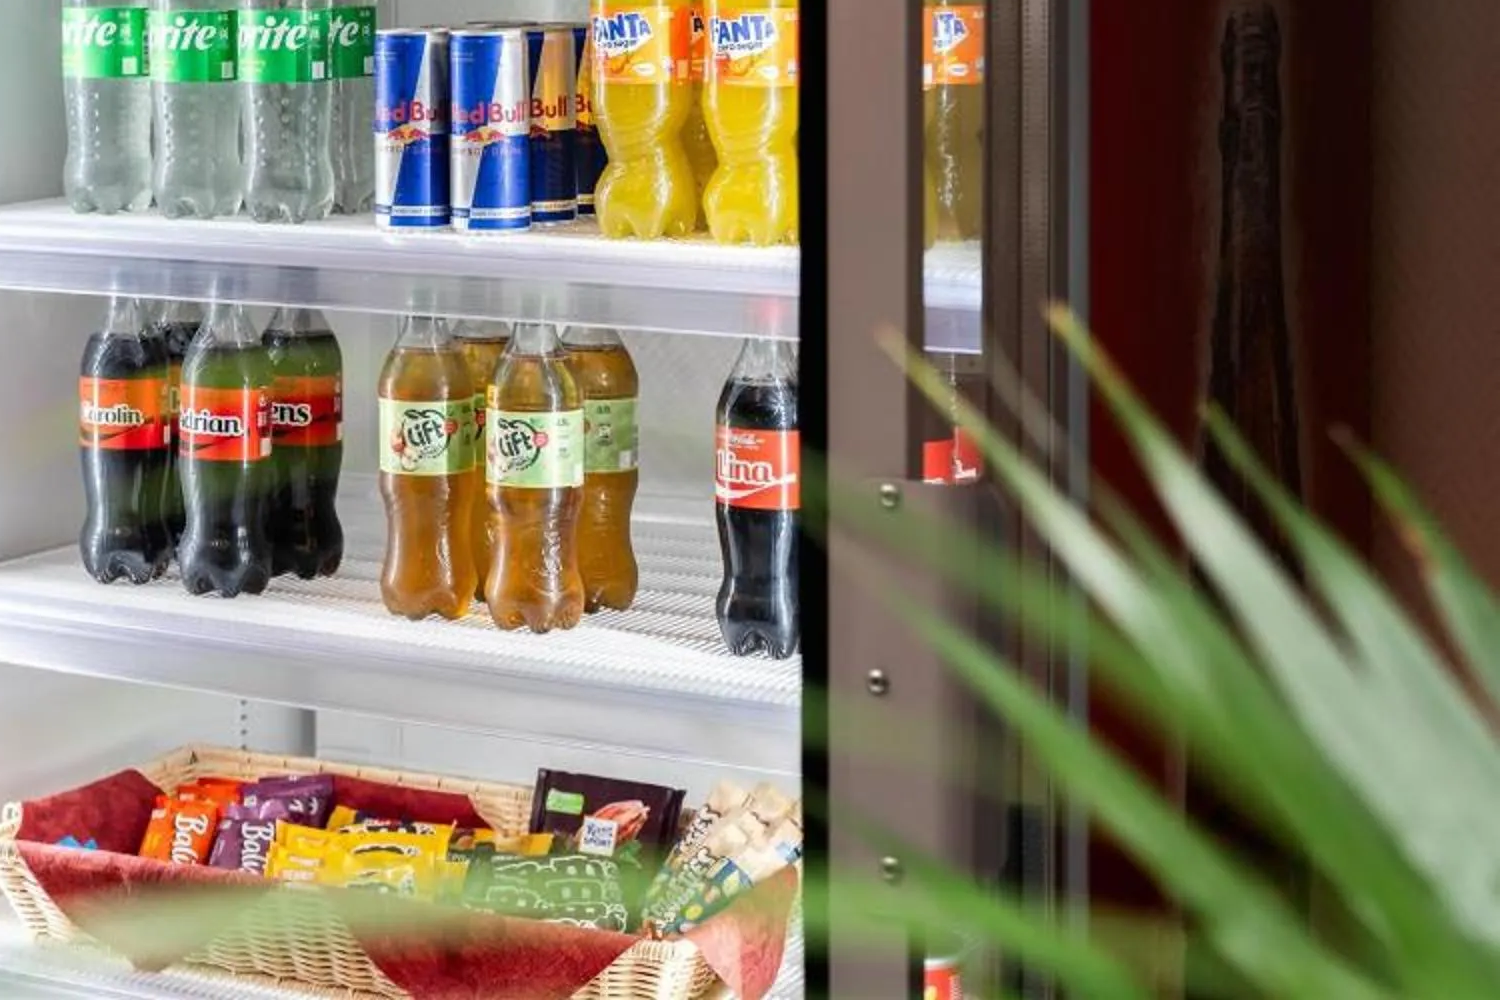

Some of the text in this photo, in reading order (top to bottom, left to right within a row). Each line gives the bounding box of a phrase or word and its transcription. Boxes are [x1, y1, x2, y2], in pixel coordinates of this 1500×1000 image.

[65, 14, 117, 47] rite
[161, 15, 217, 50] rite
[712, 15, 775, 44] FANTA
[530, 99, 568, 118] Bull
[86, 403, 142, 425] arolin
[181, 409, 242, 434] drian
